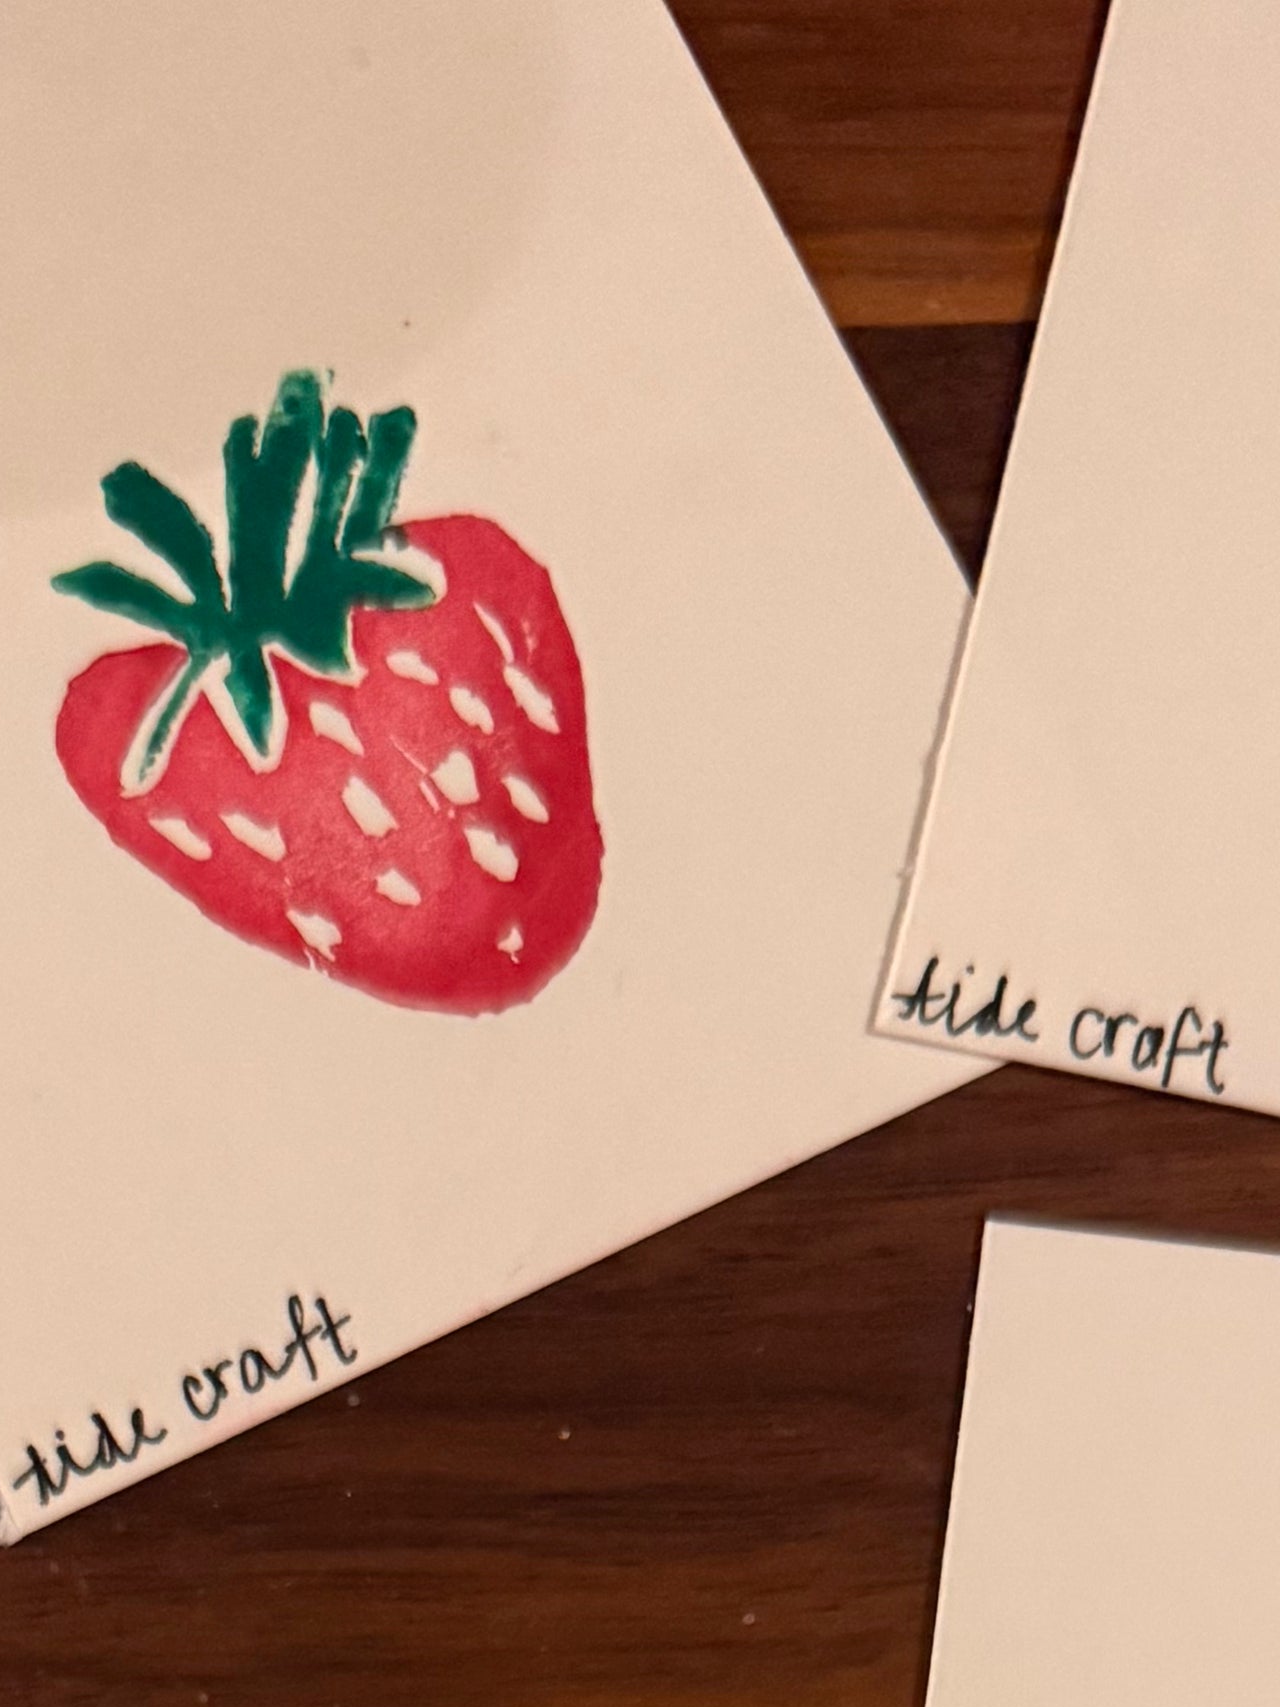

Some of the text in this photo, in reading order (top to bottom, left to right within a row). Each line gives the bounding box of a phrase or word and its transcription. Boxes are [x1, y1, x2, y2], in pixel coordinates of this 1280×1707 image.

[890, 956, 1229, 1095] tide craft
[13, 1293, 358, 1506] tide craft
